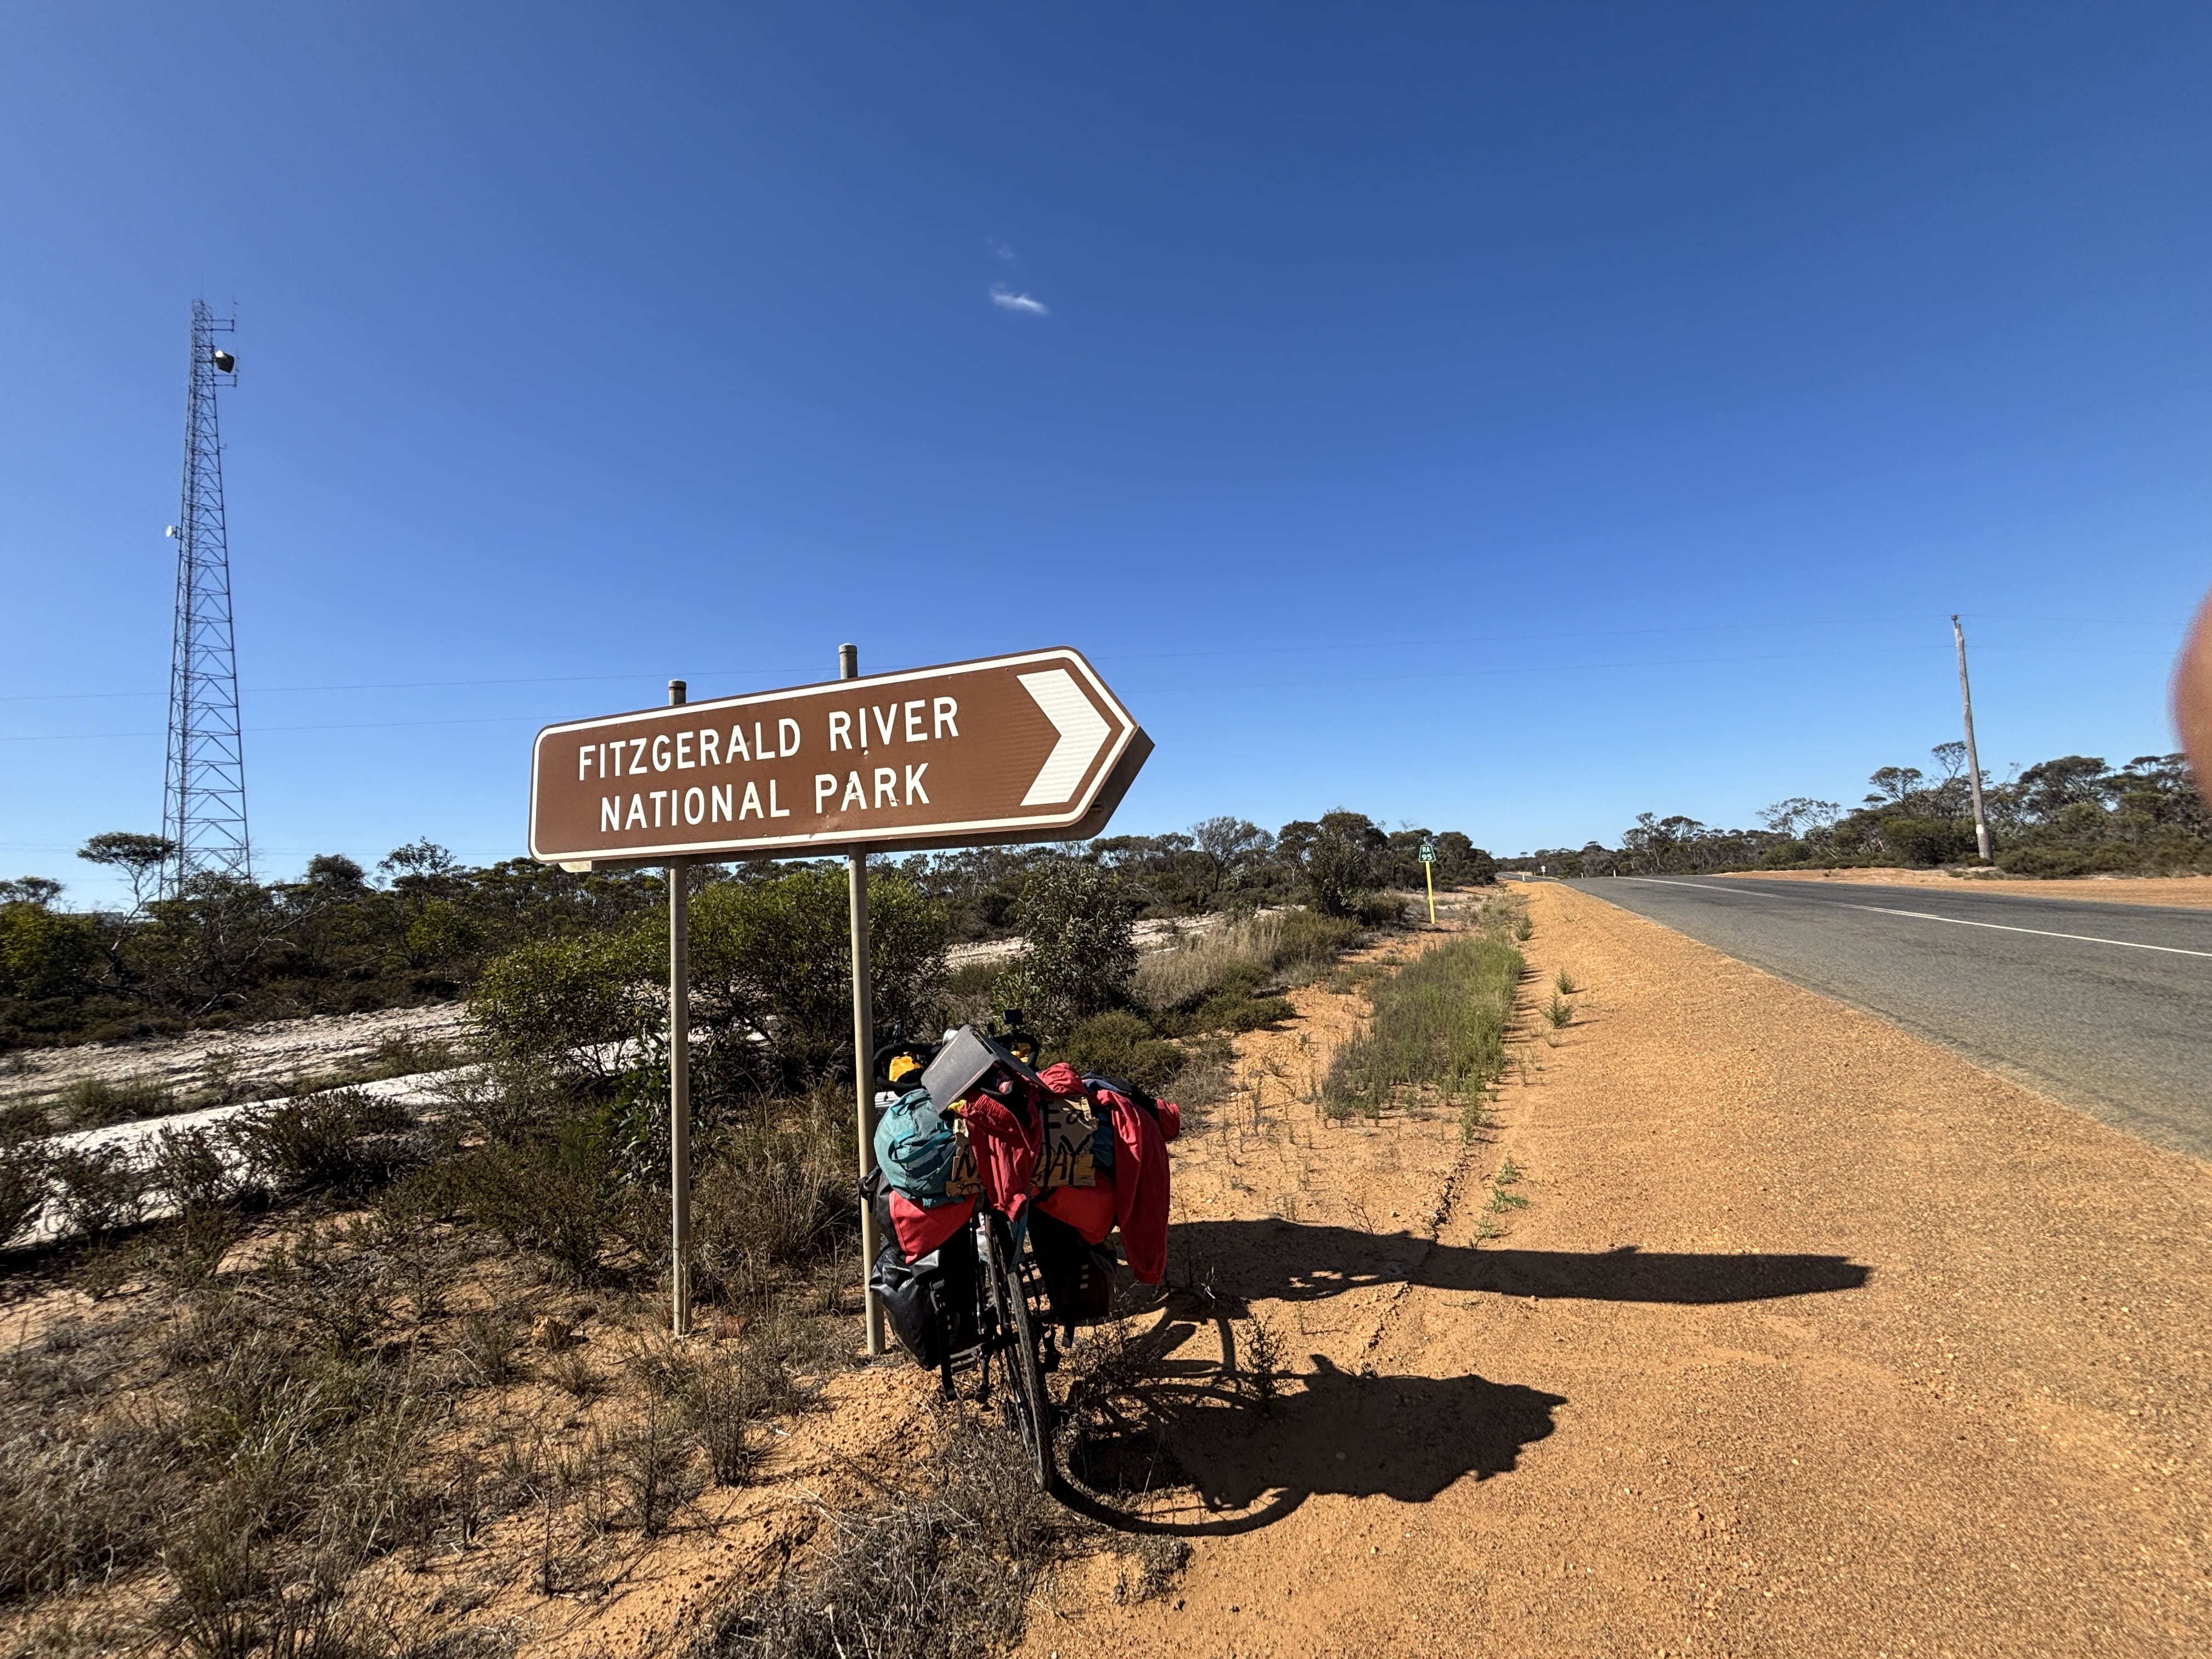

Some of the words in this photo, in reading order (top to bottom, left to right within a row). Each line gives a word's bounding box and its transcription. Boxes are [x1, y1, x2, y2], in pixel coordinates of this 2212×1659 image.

[579, 718, 800, 781] FITZGERALD
[829, 696, 959, 752] RIVER
[601, 779, 790, 832] NATIONAL
[815, 763, 930, 814] PARK
